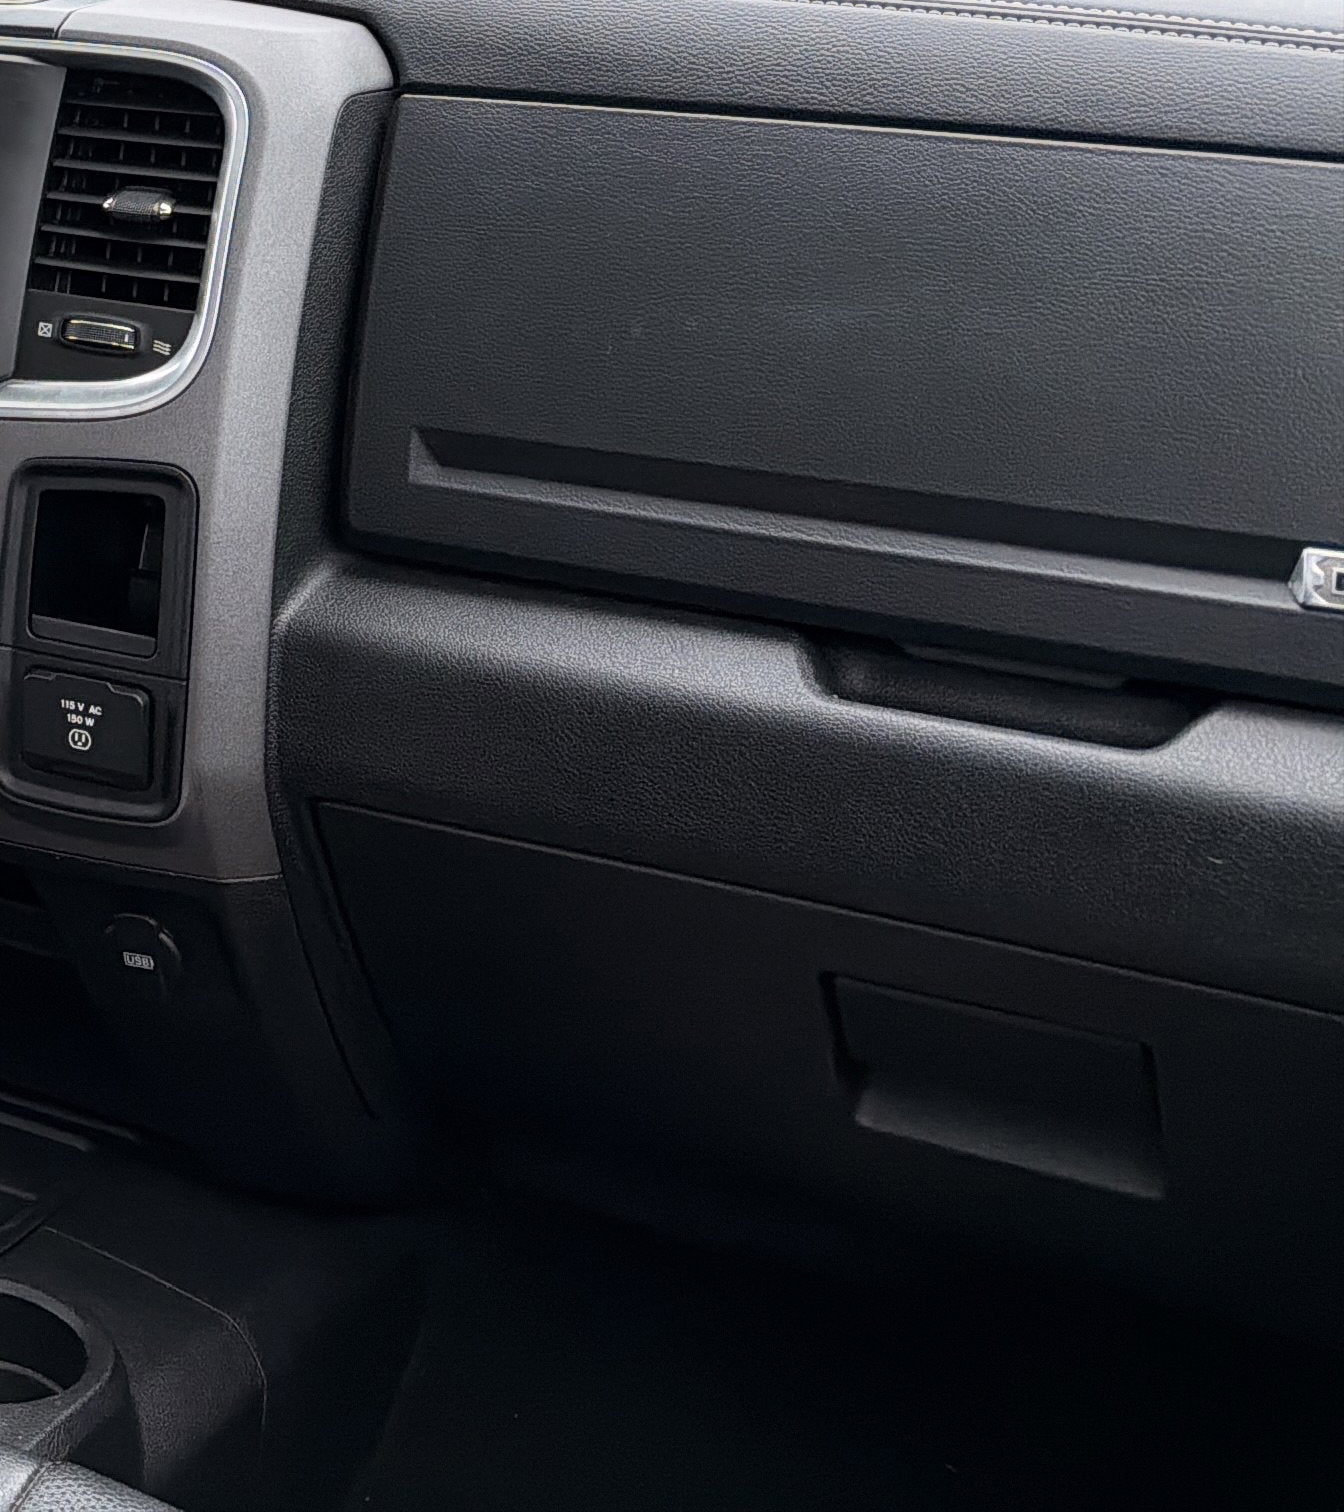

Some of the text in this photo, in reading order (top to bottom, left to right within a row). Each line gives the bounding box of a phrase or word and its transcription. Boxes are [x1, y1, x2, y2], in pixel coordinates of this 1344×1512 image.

[61, 699, 102, 715] 115 V AC
[67, 713, 95, 727] 150 W
[126, 954, 150, 966] USB
